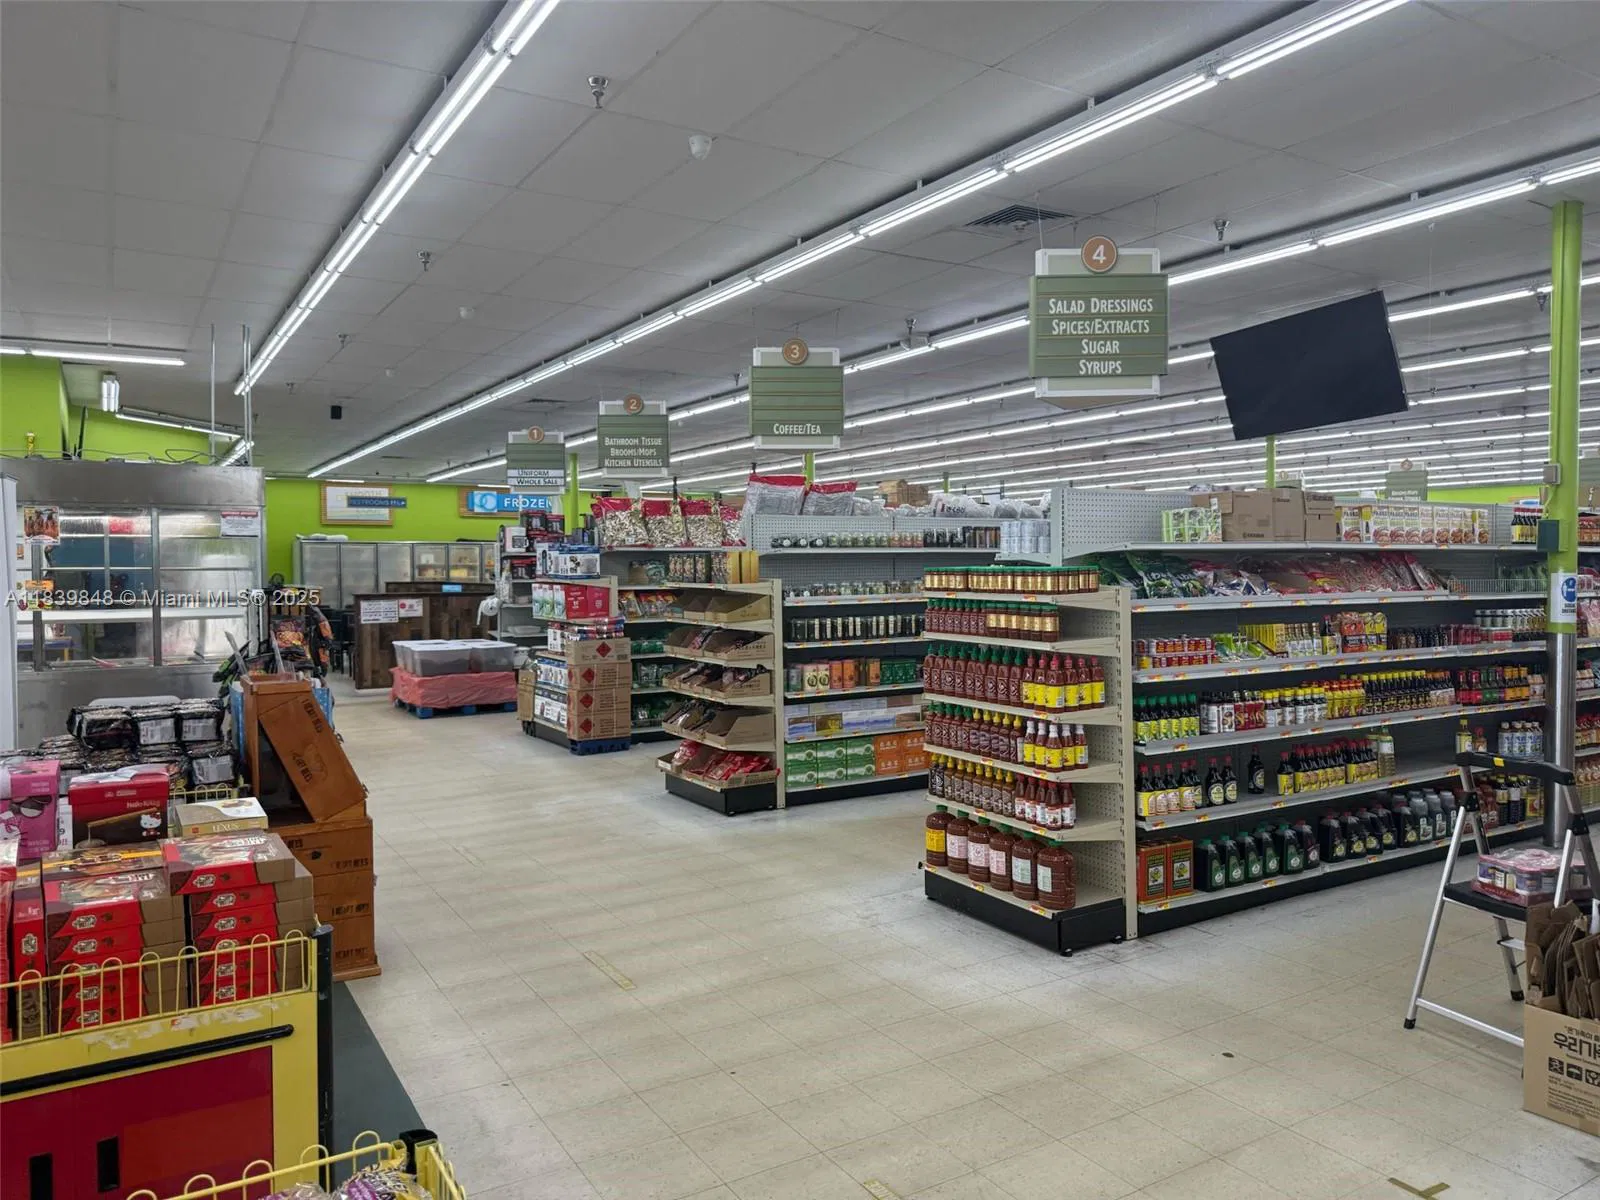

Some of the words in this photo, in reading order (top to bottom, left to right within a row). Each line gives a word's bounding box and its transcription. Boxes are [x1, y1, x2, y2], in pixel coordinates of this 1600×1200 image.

[1092, 245, 1107, 263] 4
[1049, 298, 1085, 314] SALAD
[1090, 298, 1153, 313] DRESSINGS
[1052, 319, 1150, 335] SPICES/EXTRACTS
[791, 345, 800, 358] 3
[1081, 339, 1120, 354] SUGAR
[1079, 360, 1122, 374] SYRUPS
[630, 399, 637, 409] 2
[773, 423, 821, 434] COFFEE/TEA
[604, 437, 638, 446] BATHROOM
[641, 436, 662, 446] TISSUE
[610, 448, 656, 456] BROOMS/MOPS
[604, 458, 631, 467] KITCHEN
[633, 458, 662, 467] UTENSILS
